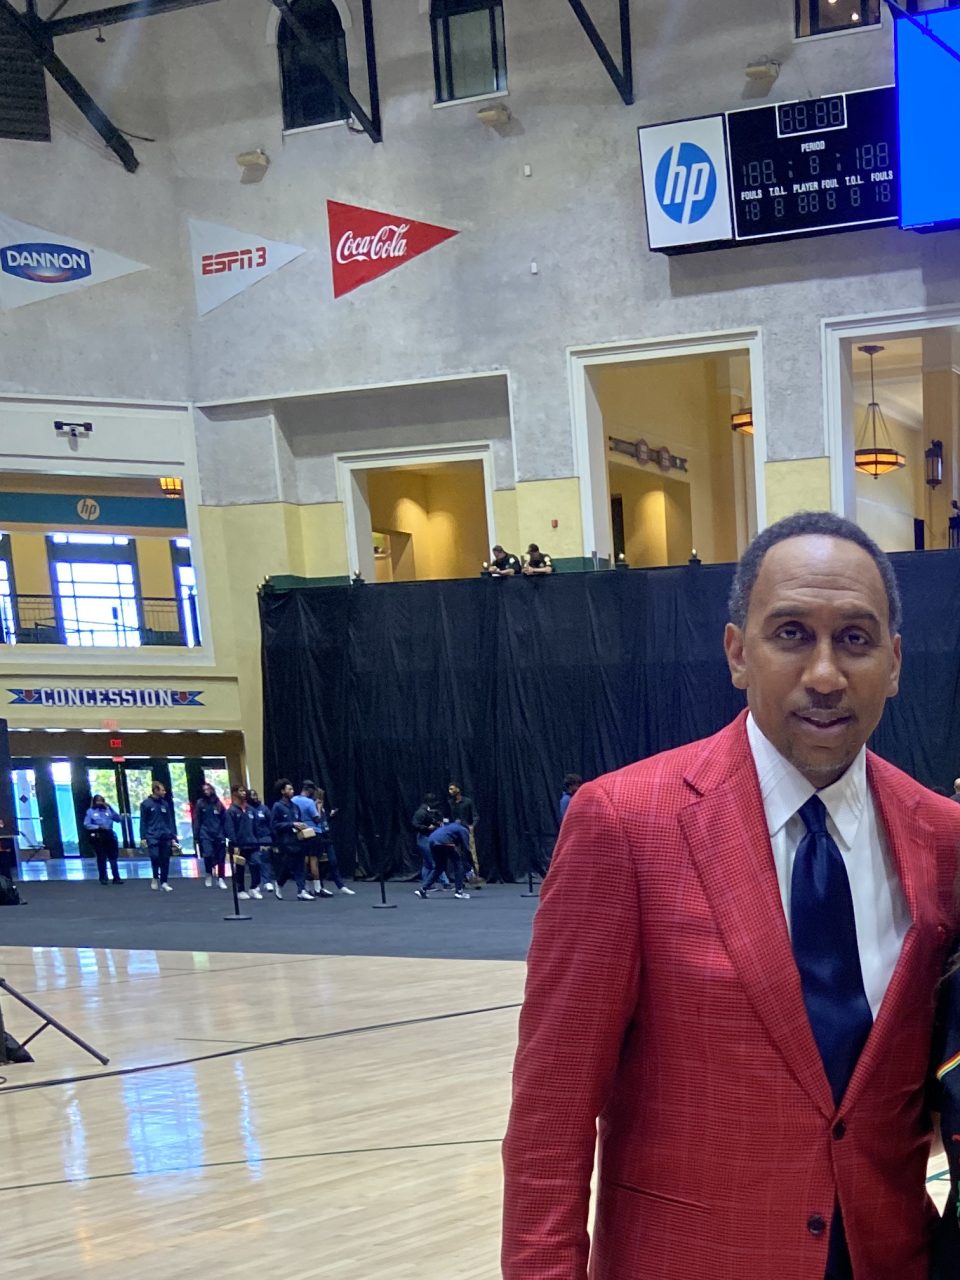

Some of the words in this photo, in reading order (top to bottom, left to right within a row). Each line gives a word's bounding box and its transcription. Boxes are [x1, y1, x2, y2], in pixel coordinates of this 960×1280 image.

[801, 140, 825, 152] PERIOD
[663, 143, 710, 224] hp
[741, 189, 762, 200] FOULS
[769, 186, 787, 197] T.O.L.
[793, 181, 819, 193] PLAYER
[821, 178, 839, 189] FOUL
[845, 175, 864, 186] T.O.L.
[871, 170, 893, 182] FOULS
[336, 224, 409, 264] Coca-Cola
[7, 250, 86, 269] DANNON
[80, 499, 97, 520] hp
[41, 687, 173, 707] CONCESSION
